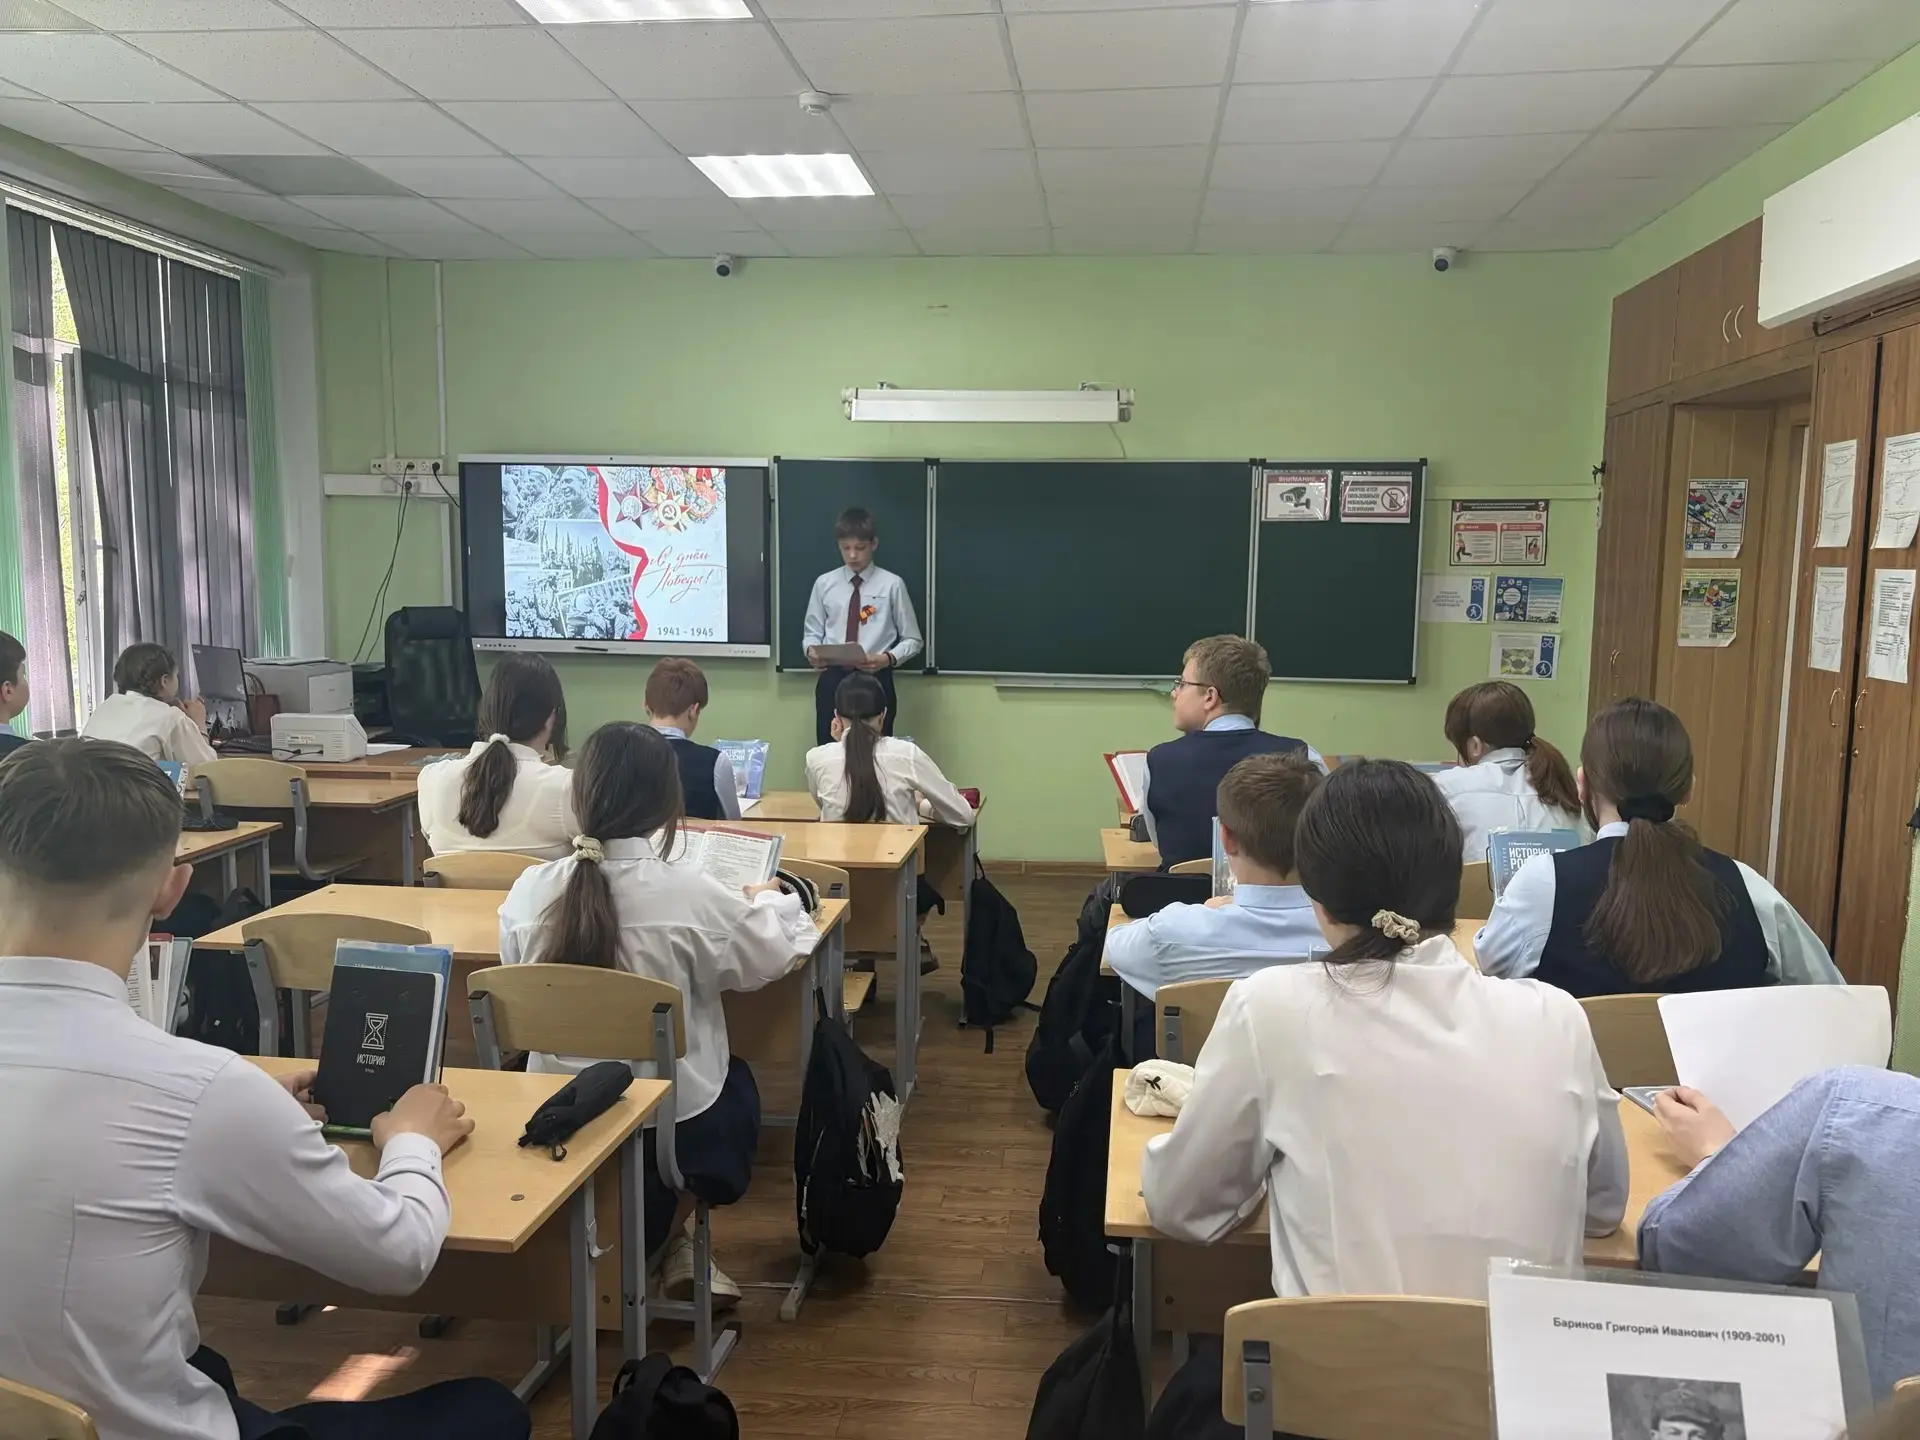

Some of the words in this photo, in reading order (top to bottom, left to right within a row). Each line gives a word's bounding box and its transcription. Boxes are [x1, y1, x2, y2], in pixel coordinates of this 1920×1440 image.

[646, 563, 714, 603] Победы!
[657, 626, 680, 636] 1941
[690, 627, 714, 637] 1945
[1508, 847, 1550, 859] ИСТОРИЯ
[356, 1053, 386, 1066] ИСТОРИЯ
[1553, 1317, 1602, 1330] Баринов
[1605, 1320, 1659, 1335] Григорий
[1662, 1326, 1719, 1339] Иванович
[1721, 1330, 1786, 1346] (1909-2001)
